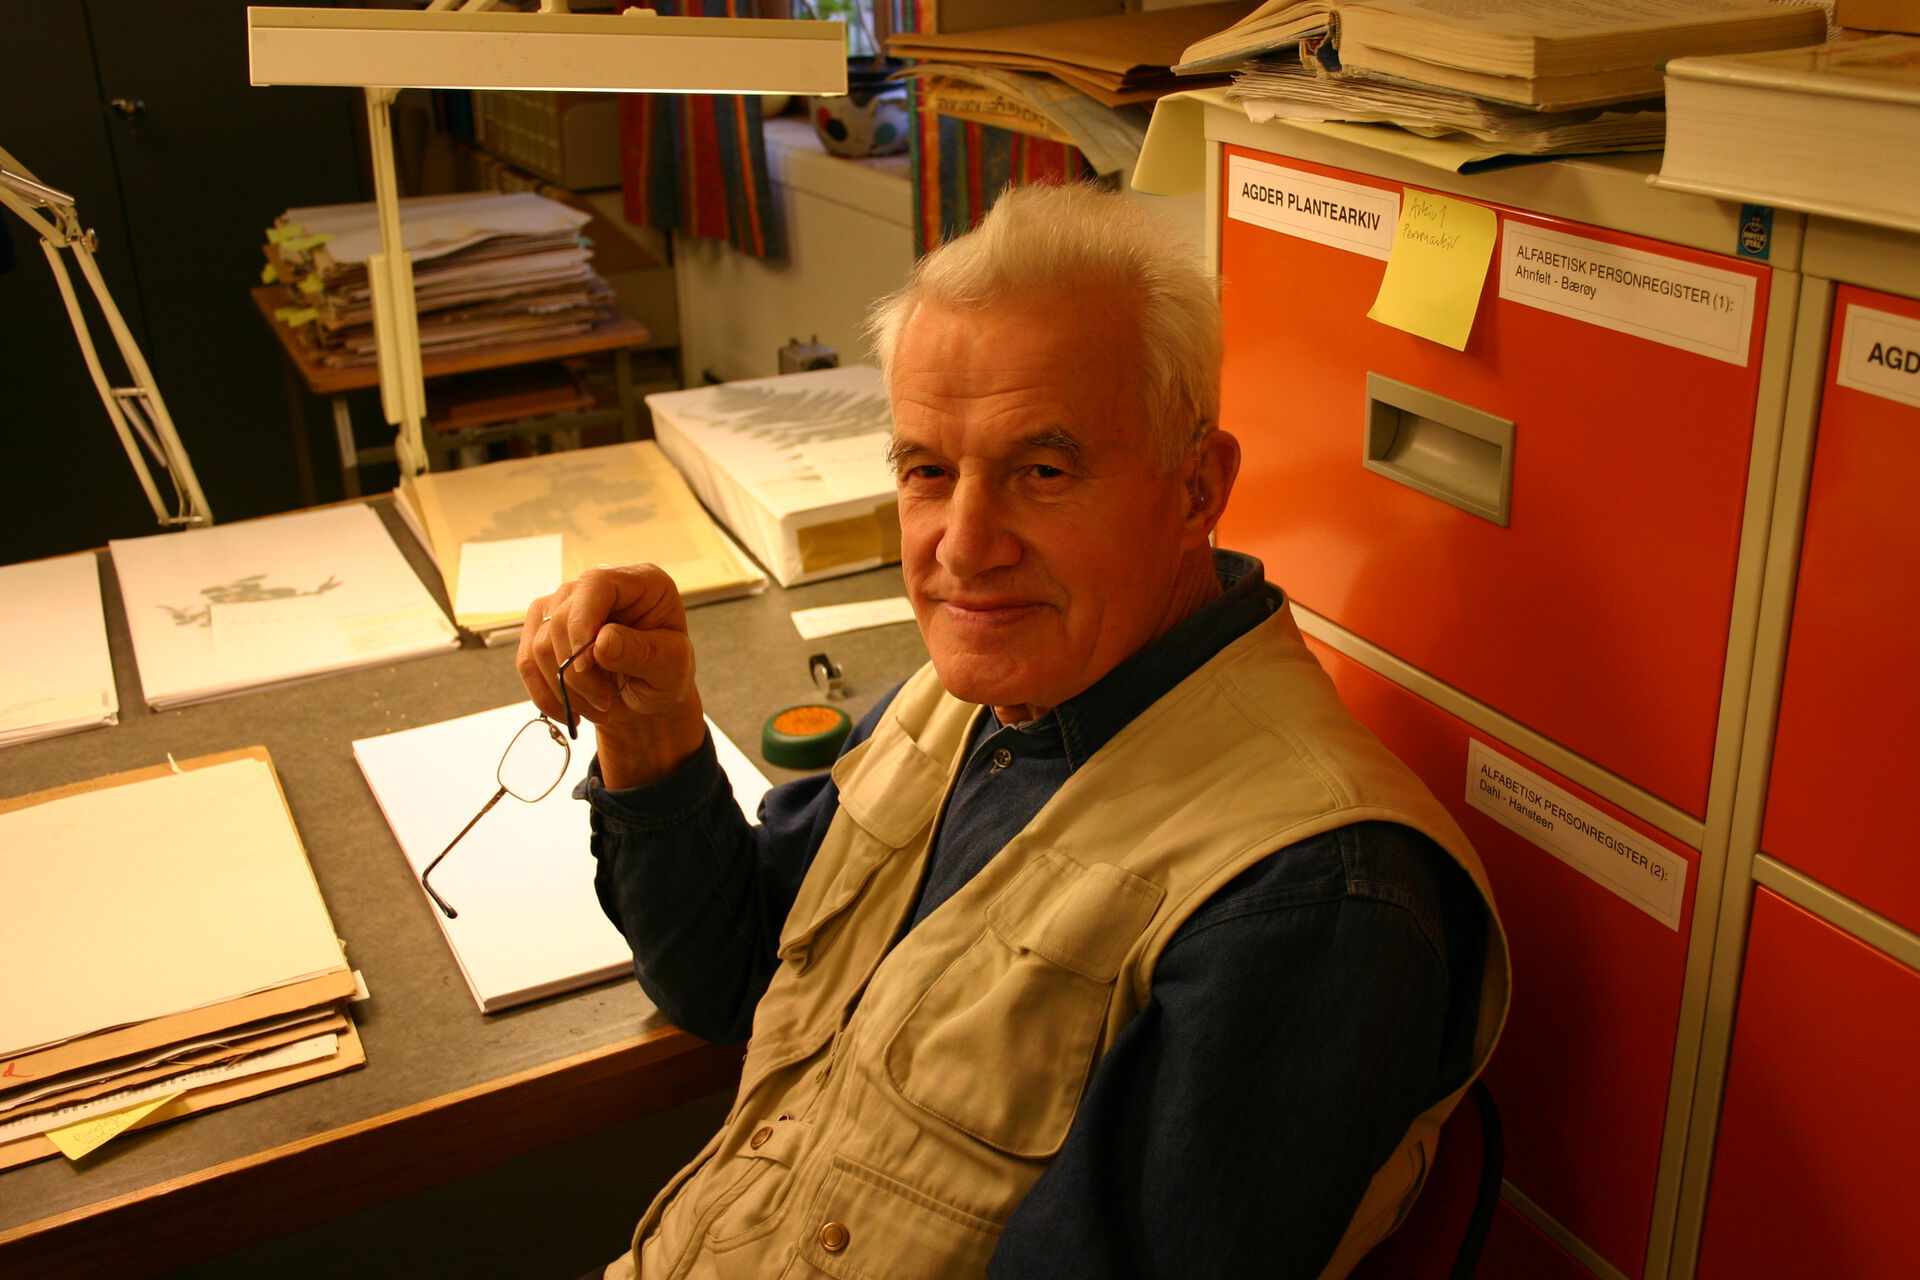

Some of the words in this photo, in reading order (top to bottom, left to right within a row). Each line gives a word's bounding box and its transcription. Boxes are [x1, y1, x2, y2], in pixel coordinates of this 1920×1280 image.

[1241, 182, 1284, 208] AGDER
[1287, 192, 1381, 231] PLANTEARKIV
[1515, 264, 1552, 286] Ahnfelt
[1560, 276, 1598, 301] Bærøy
[1516, 244, 1588, 275] ALFABETISK
[1589, 262, 1711, 306] PERSONREGISTER
[1712, 292, 1735, 313] (1):
[1867, 342, 1920, 374] AGD
[1479, 779, 1501, 800] Dahl
[1508, 796, 1555, 832] Hansteen
[1480, 763, 1543, 808] ALFABETISK
[1544, 799, 1649, 870] PERSONREGISTER
[1649, 862, 1669, 881] (2):
